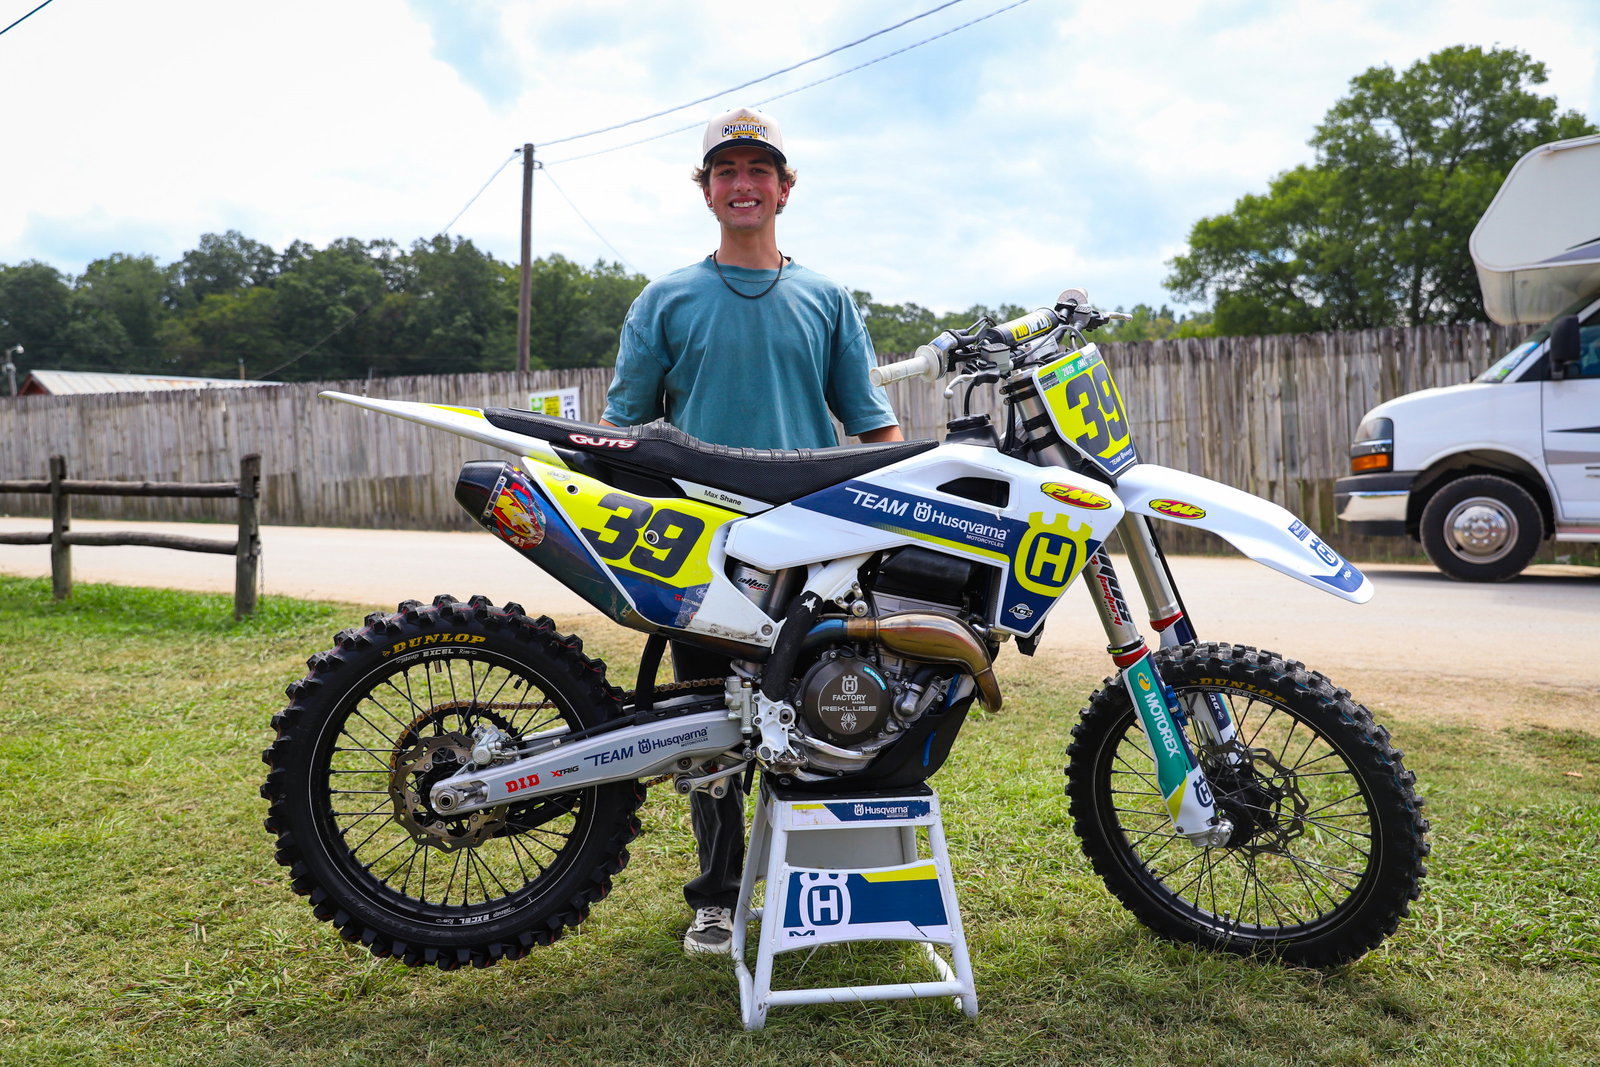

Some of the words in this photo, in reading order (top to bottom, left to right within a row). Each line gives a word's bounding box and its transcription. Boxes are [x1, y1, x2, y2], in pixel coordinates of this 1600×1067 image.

[722, 124, 768, 140] CHAMPION
[1066, 362, 1128, 450] 39
[568, 433, 637, 449] GUTS
[703, 490, 719, 499] Max
[719, 494, 742, 506] Shane
[1042, 483, 1110, 508] FMF
[845, 486, 909, 517] TEAM
[931, 510, 1007, 541] Husqvarna
[1150, 499, 1205, 518] FMF
[580, 492, 705, 578] 39
[966, 534, 1005, 548] MOTORCYCLES
[392, 633, 487, 655] DUNLOP
[423, 648, 454, 658] EXCEL
[1199, 677, 1288, 703] DUNLOP
[1144, 692, 1181, 758] MOTOREX
[584, 745, 634, 767] TEAM
[652, 728, 708, 750] Husqvarna
[551, 765, 580, 778] XTRIG
[864, 806, 909, 815] Husqvarna
